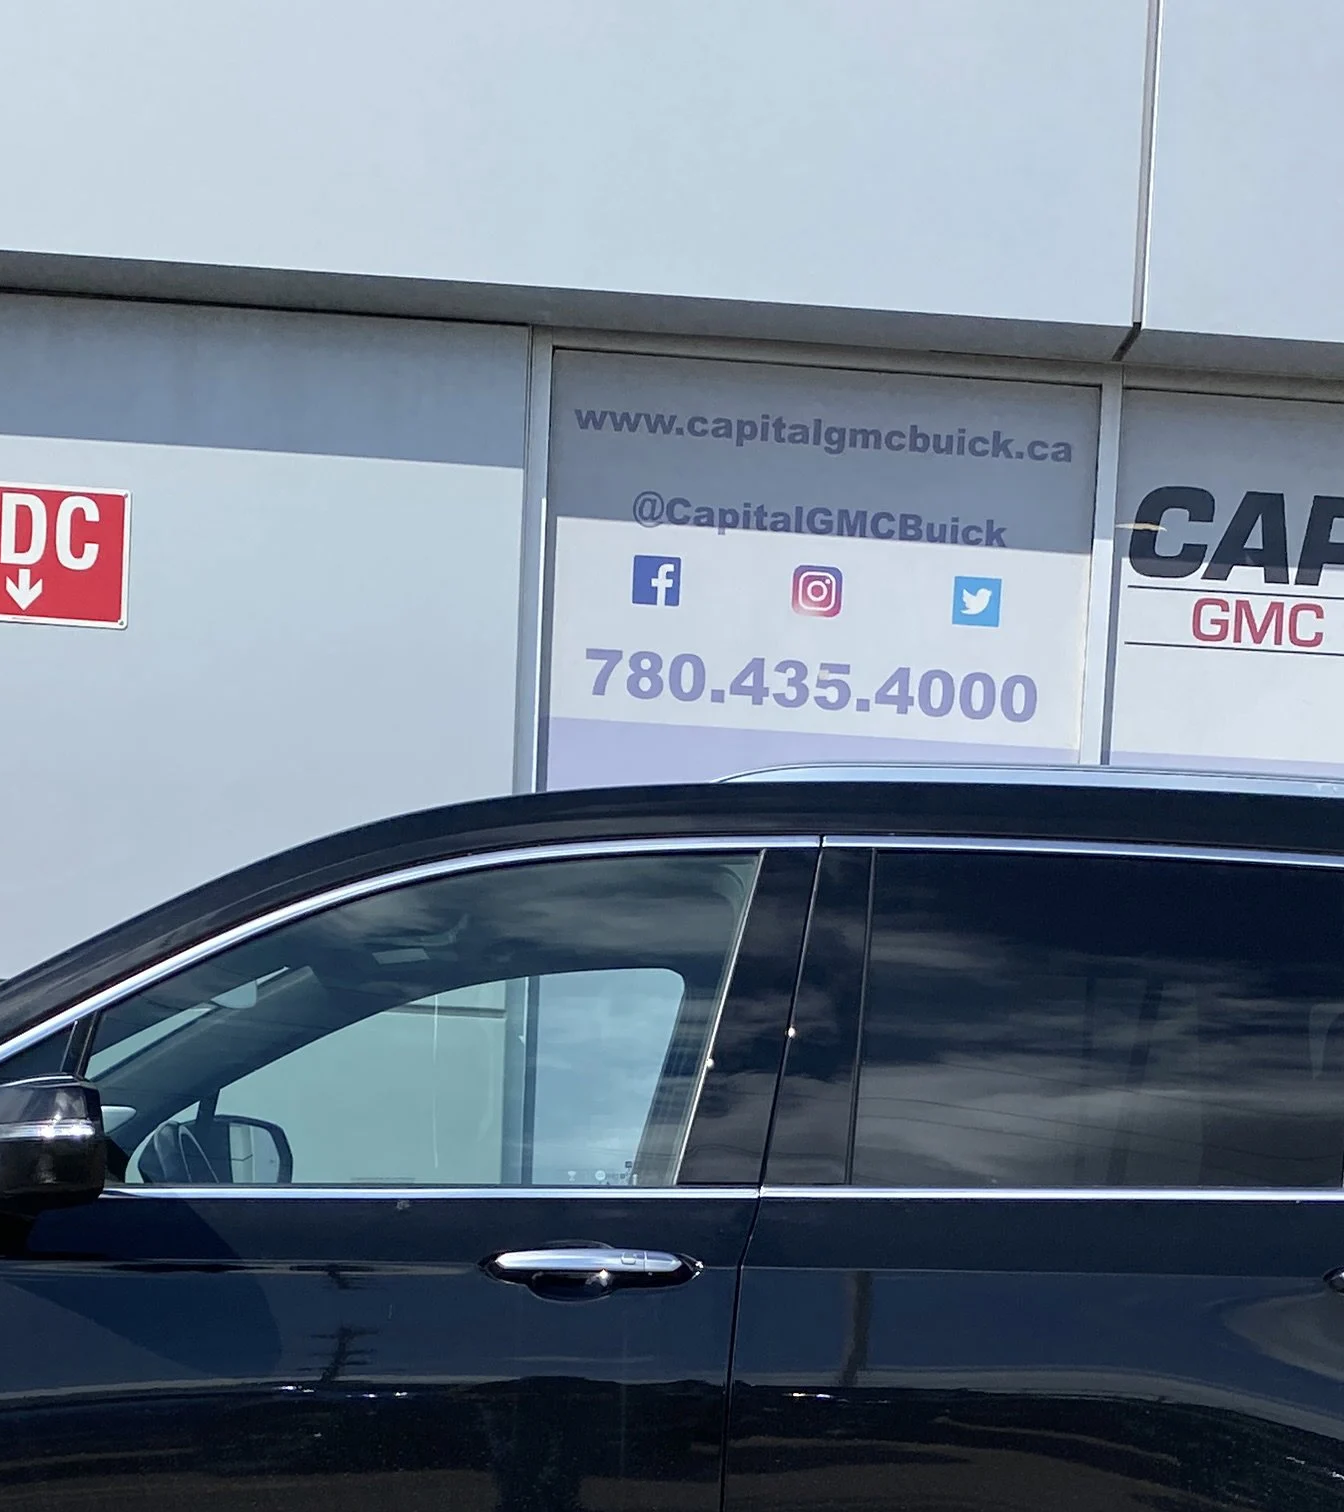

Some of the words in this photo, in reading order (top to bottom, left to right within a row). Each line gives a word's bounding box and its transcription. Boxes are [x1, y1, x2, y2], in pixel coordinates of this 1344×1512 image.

[574, 406, 1072, 464] www.capitalgmcbuick.ca
[632, 491, 1008, 548] @CapitalGMCBuick
[1191, 598, 1324, 648] GMC
[585, 648, 1038, 723] 780.435.4000
